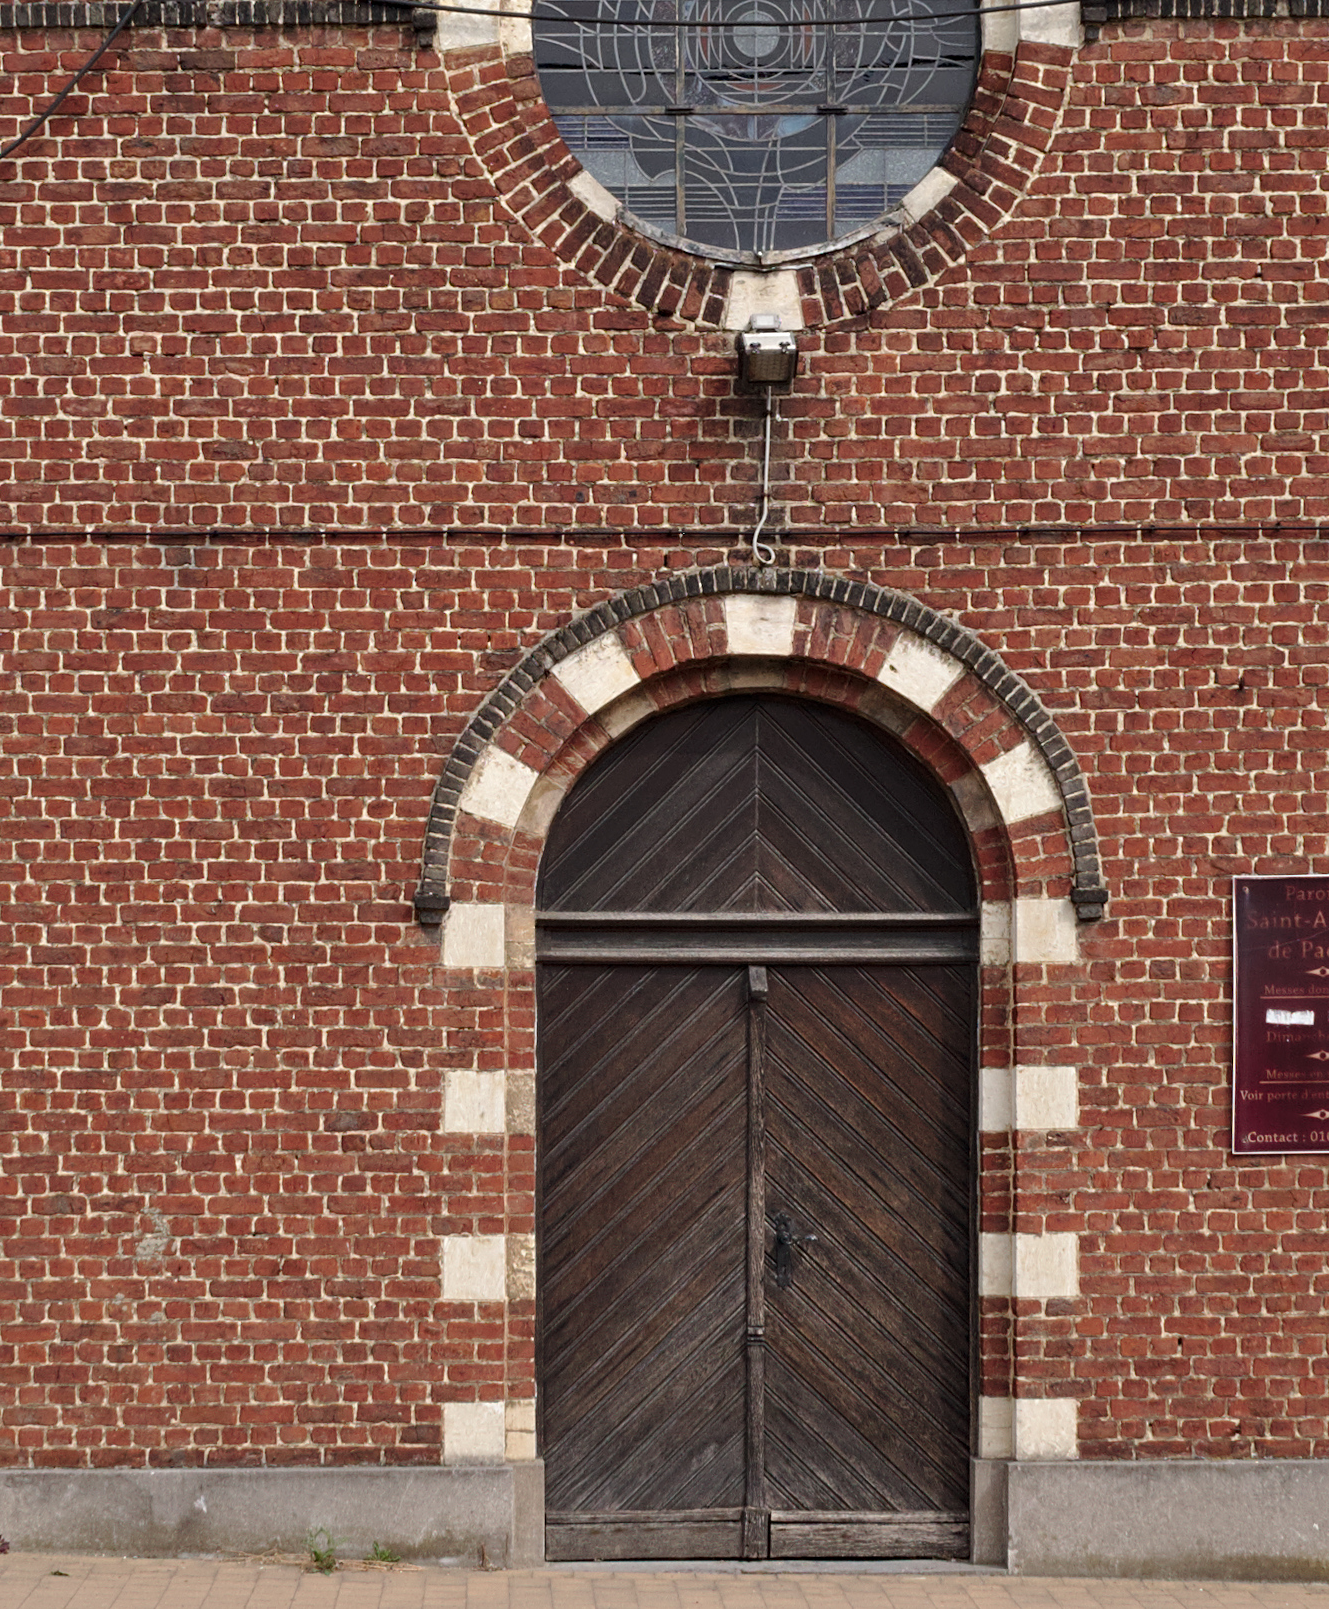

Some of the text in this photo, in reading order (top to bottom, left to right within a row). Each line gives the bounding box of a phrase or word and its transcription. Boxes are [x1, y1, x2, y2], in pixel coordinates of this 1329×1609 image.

[1268, 940, 1292, 959] de
[1264, 984, 1304, 995] Messes
[1266, 1069, 1305, 1079] Messes
[1240, 1089, 1264, 1101] Voir
[1267, 1090, 1298, 1103] porte
[1247, 1131, 1298, 1143] Contact
